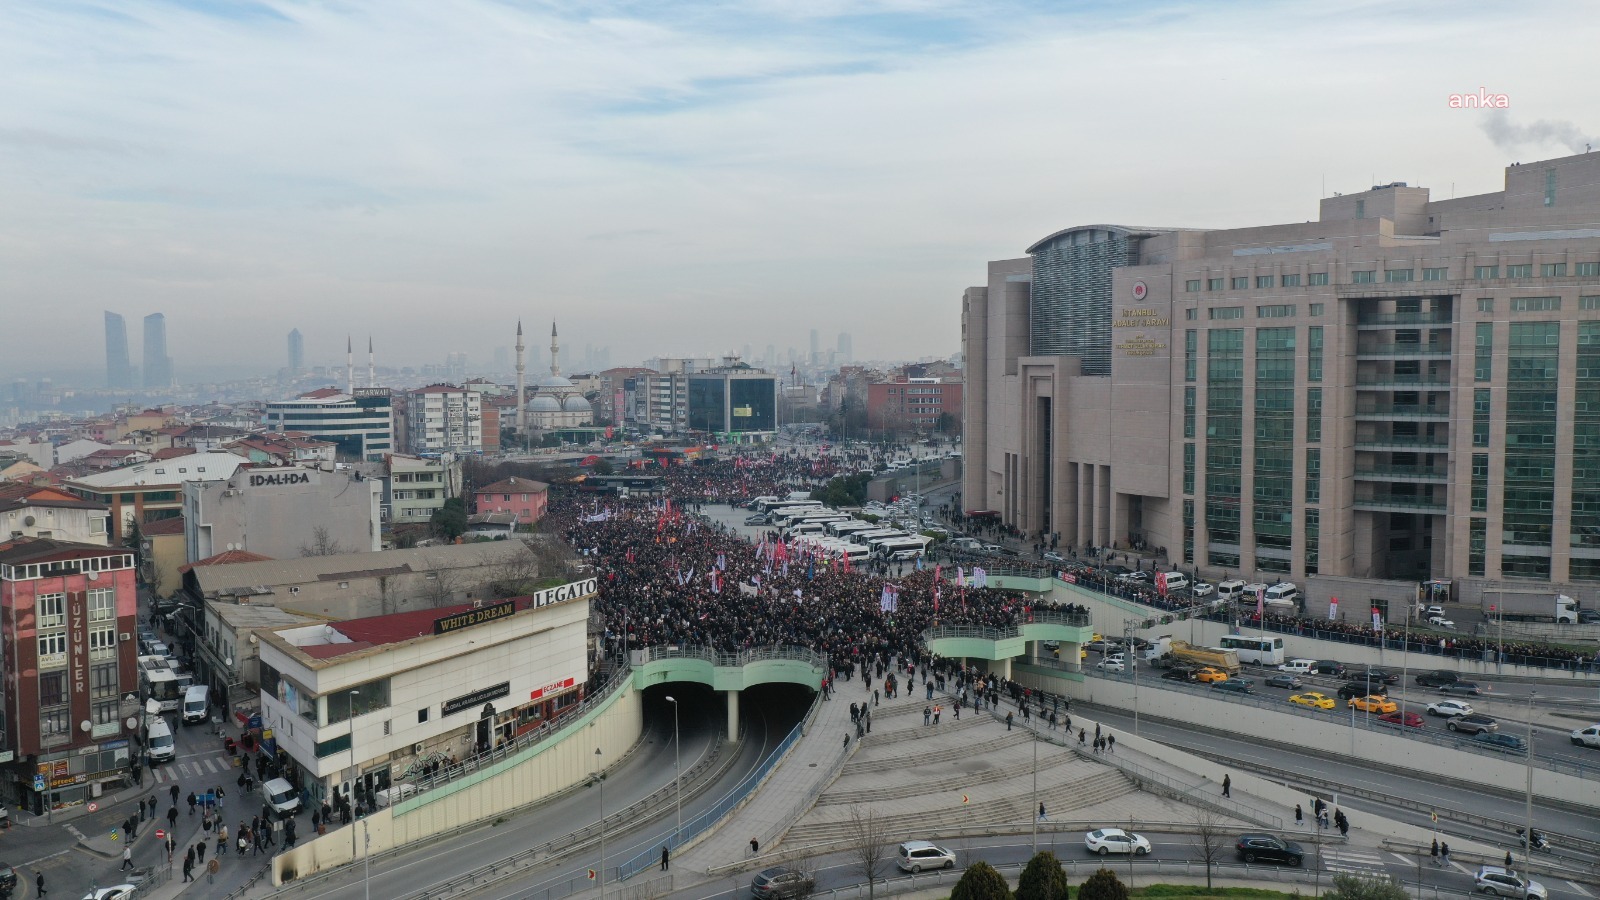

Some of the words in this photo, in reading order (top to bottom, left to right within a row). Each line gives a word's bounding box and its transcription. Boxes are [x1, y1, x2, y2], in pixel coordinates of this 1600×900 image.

[535, 579, 597, 607] LEGATO
[441, 614, 475, 631] WHITE
[477, 604, 512, 622] DREAM
[73, 591, 84, 693] TÜZÜNLER
[543, 680, 564, 692] ECZANE
[444, 701, 462, 712] GLOBAL
